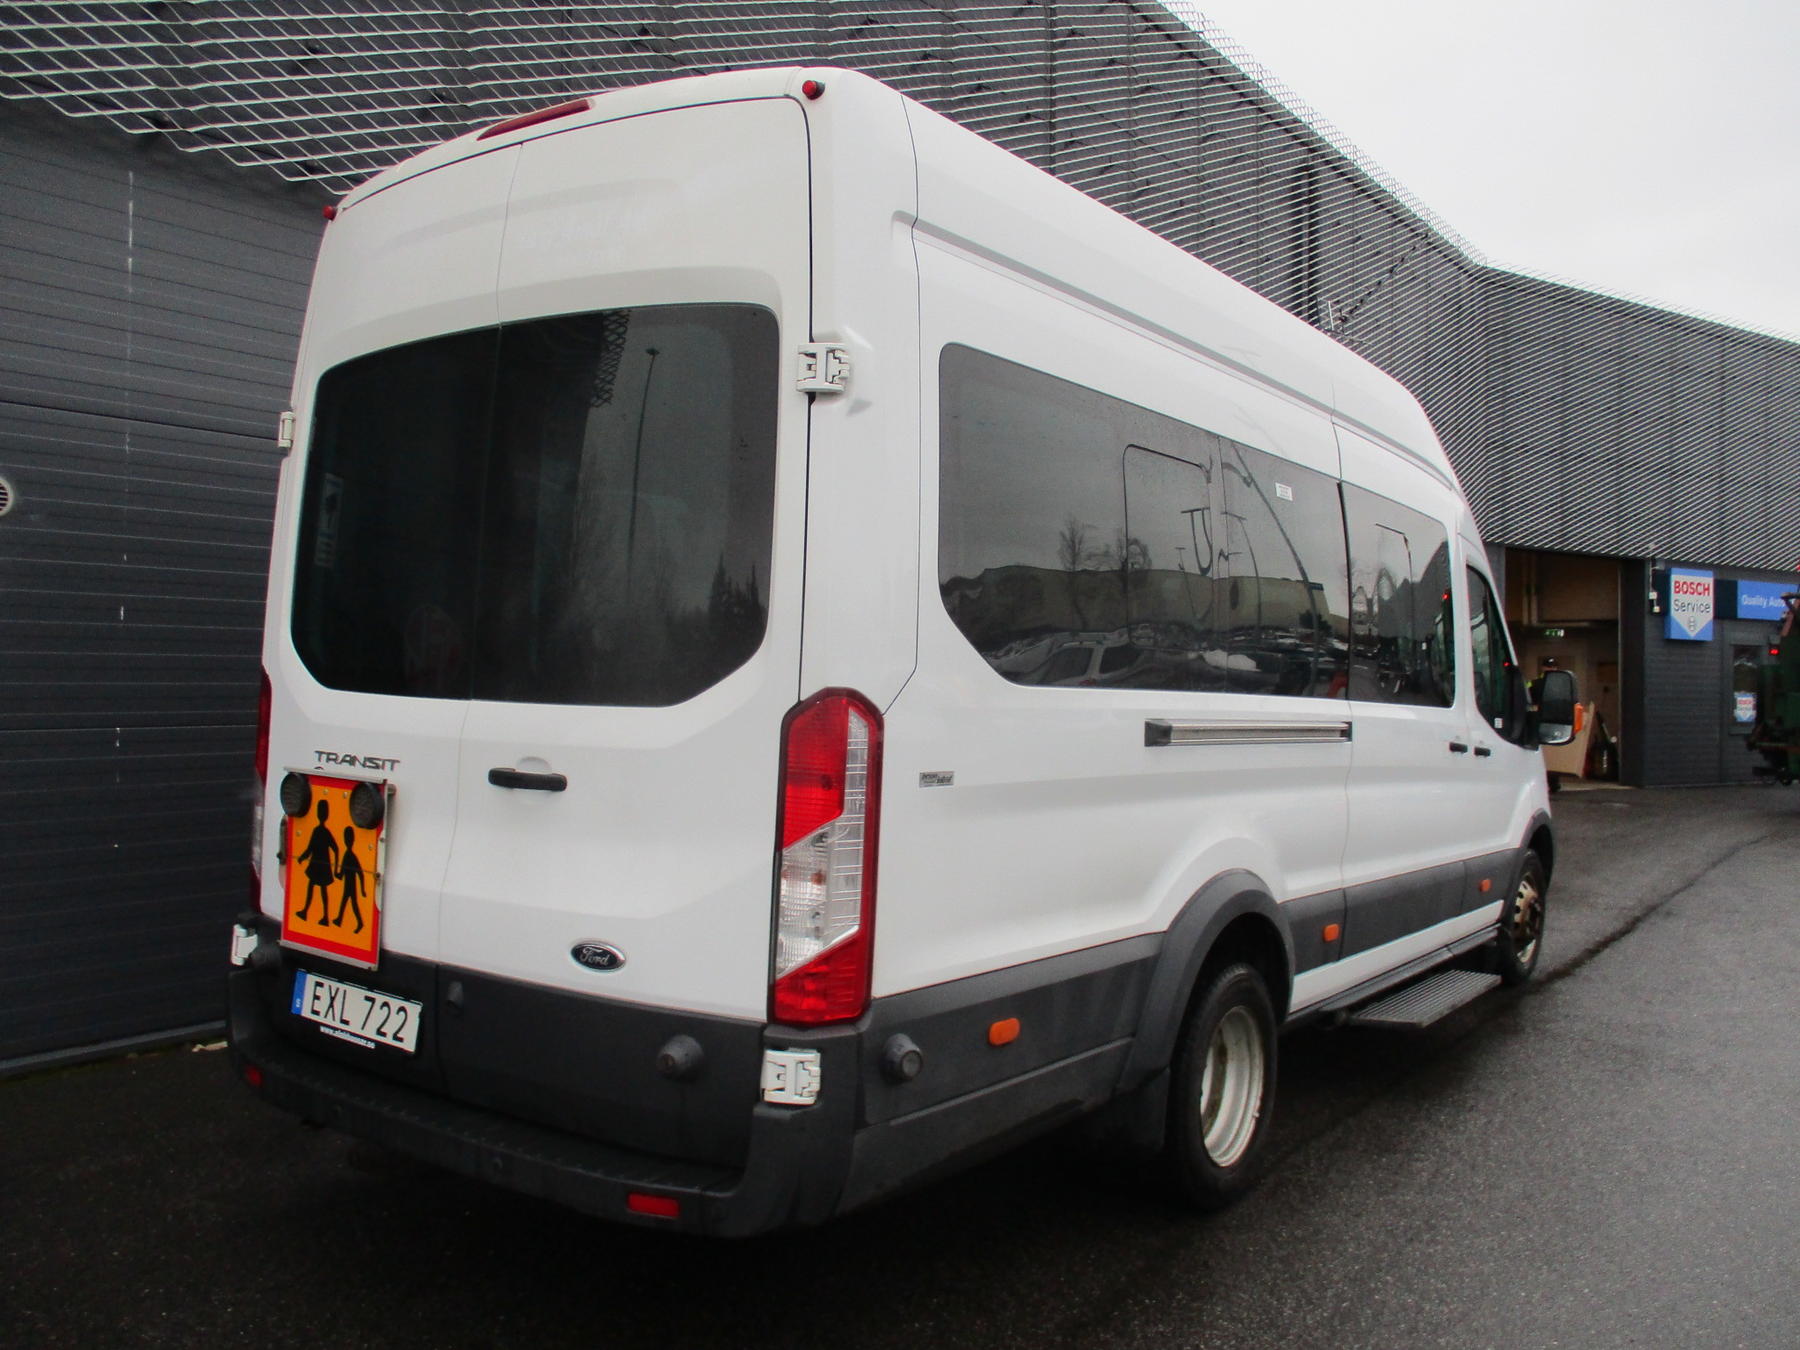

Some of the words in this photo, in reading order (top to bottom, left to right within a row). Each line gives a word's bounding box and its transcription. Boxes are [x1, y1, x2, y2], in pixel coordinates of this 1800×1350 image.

[1673, 580, 1711, 596] BOSCH
[1673, 599, 1711, 613] Service
[314, 750, 401, 771] TRANSIT
[580, 946, 610, 966] Ford
[310, 980, 350, 1026] EXL
[360, 995, 408, 1043] 722
